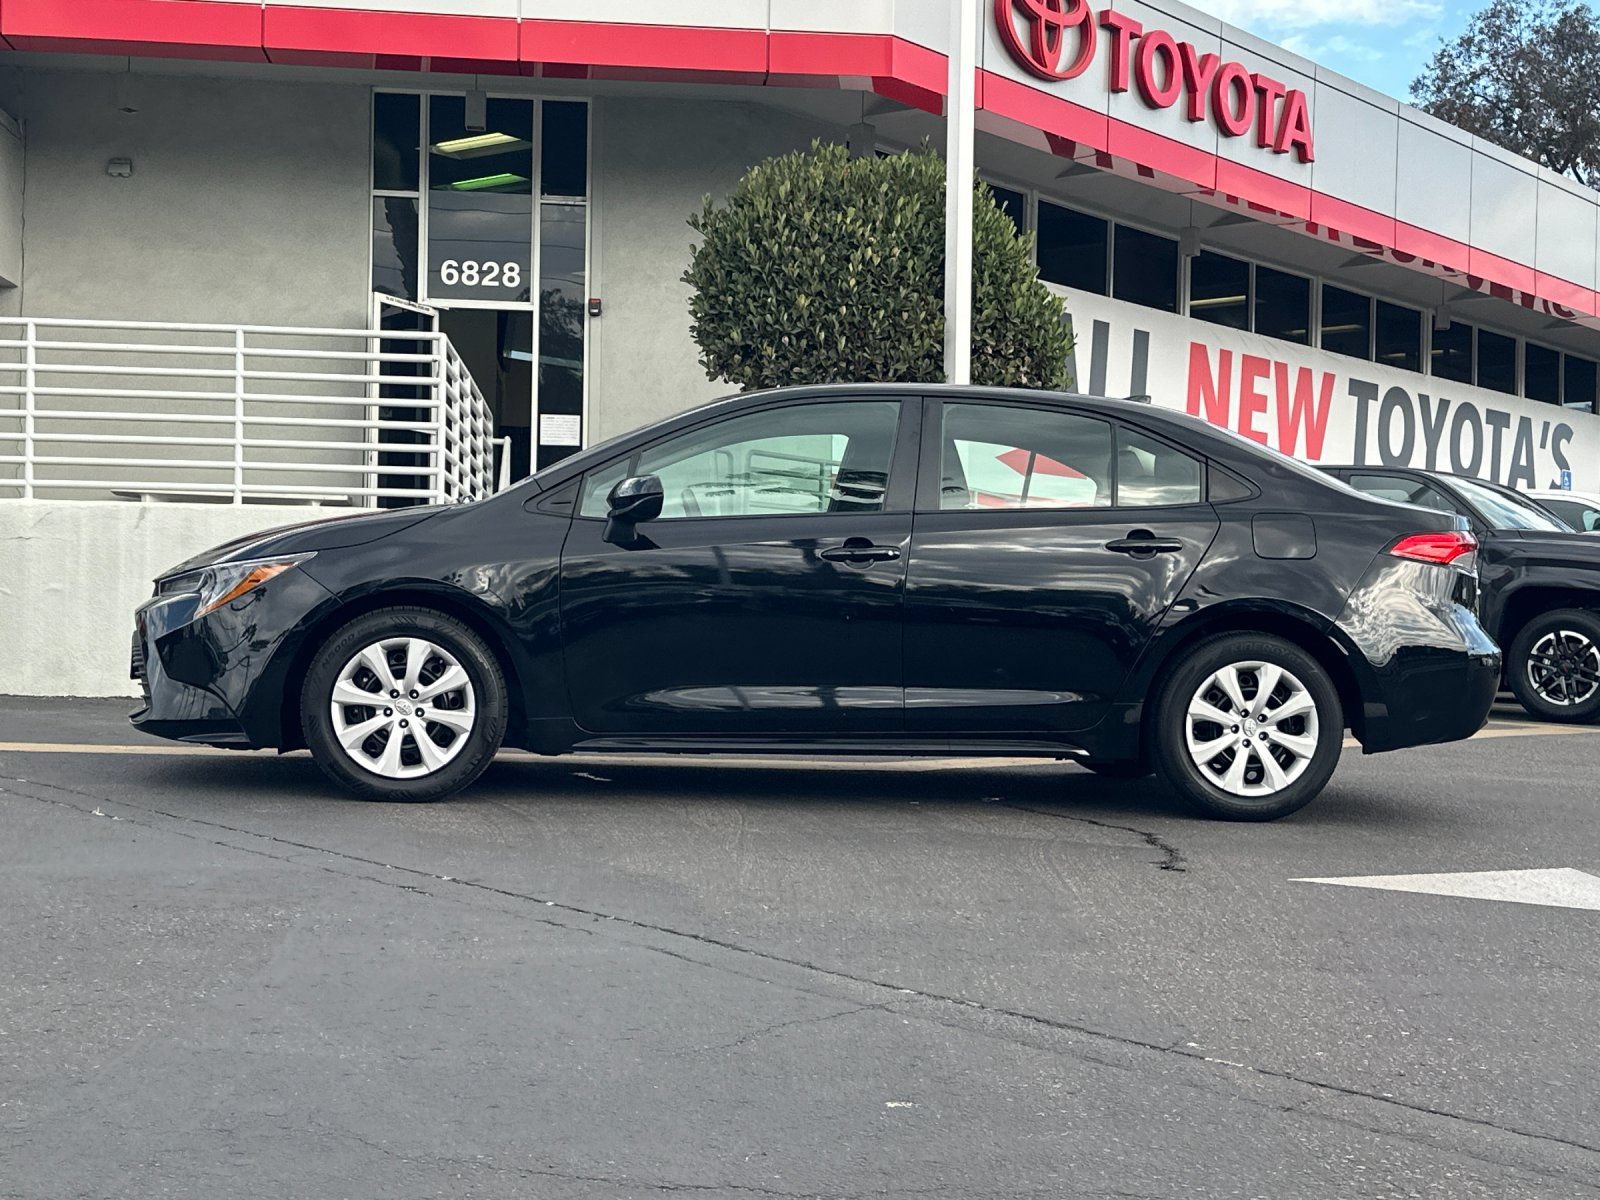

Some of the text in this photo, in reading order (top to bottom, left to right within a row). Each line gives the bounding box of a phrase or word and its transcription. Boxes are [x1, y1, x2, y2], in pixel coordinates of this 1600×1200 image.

[1100, 9, 1315, 163] TOYOTA
[440, 259, 521, 288] 6828
[1186, 341, 1336, 461] NEW
[1348, 377, 1574, 490] TOYOTA'S
